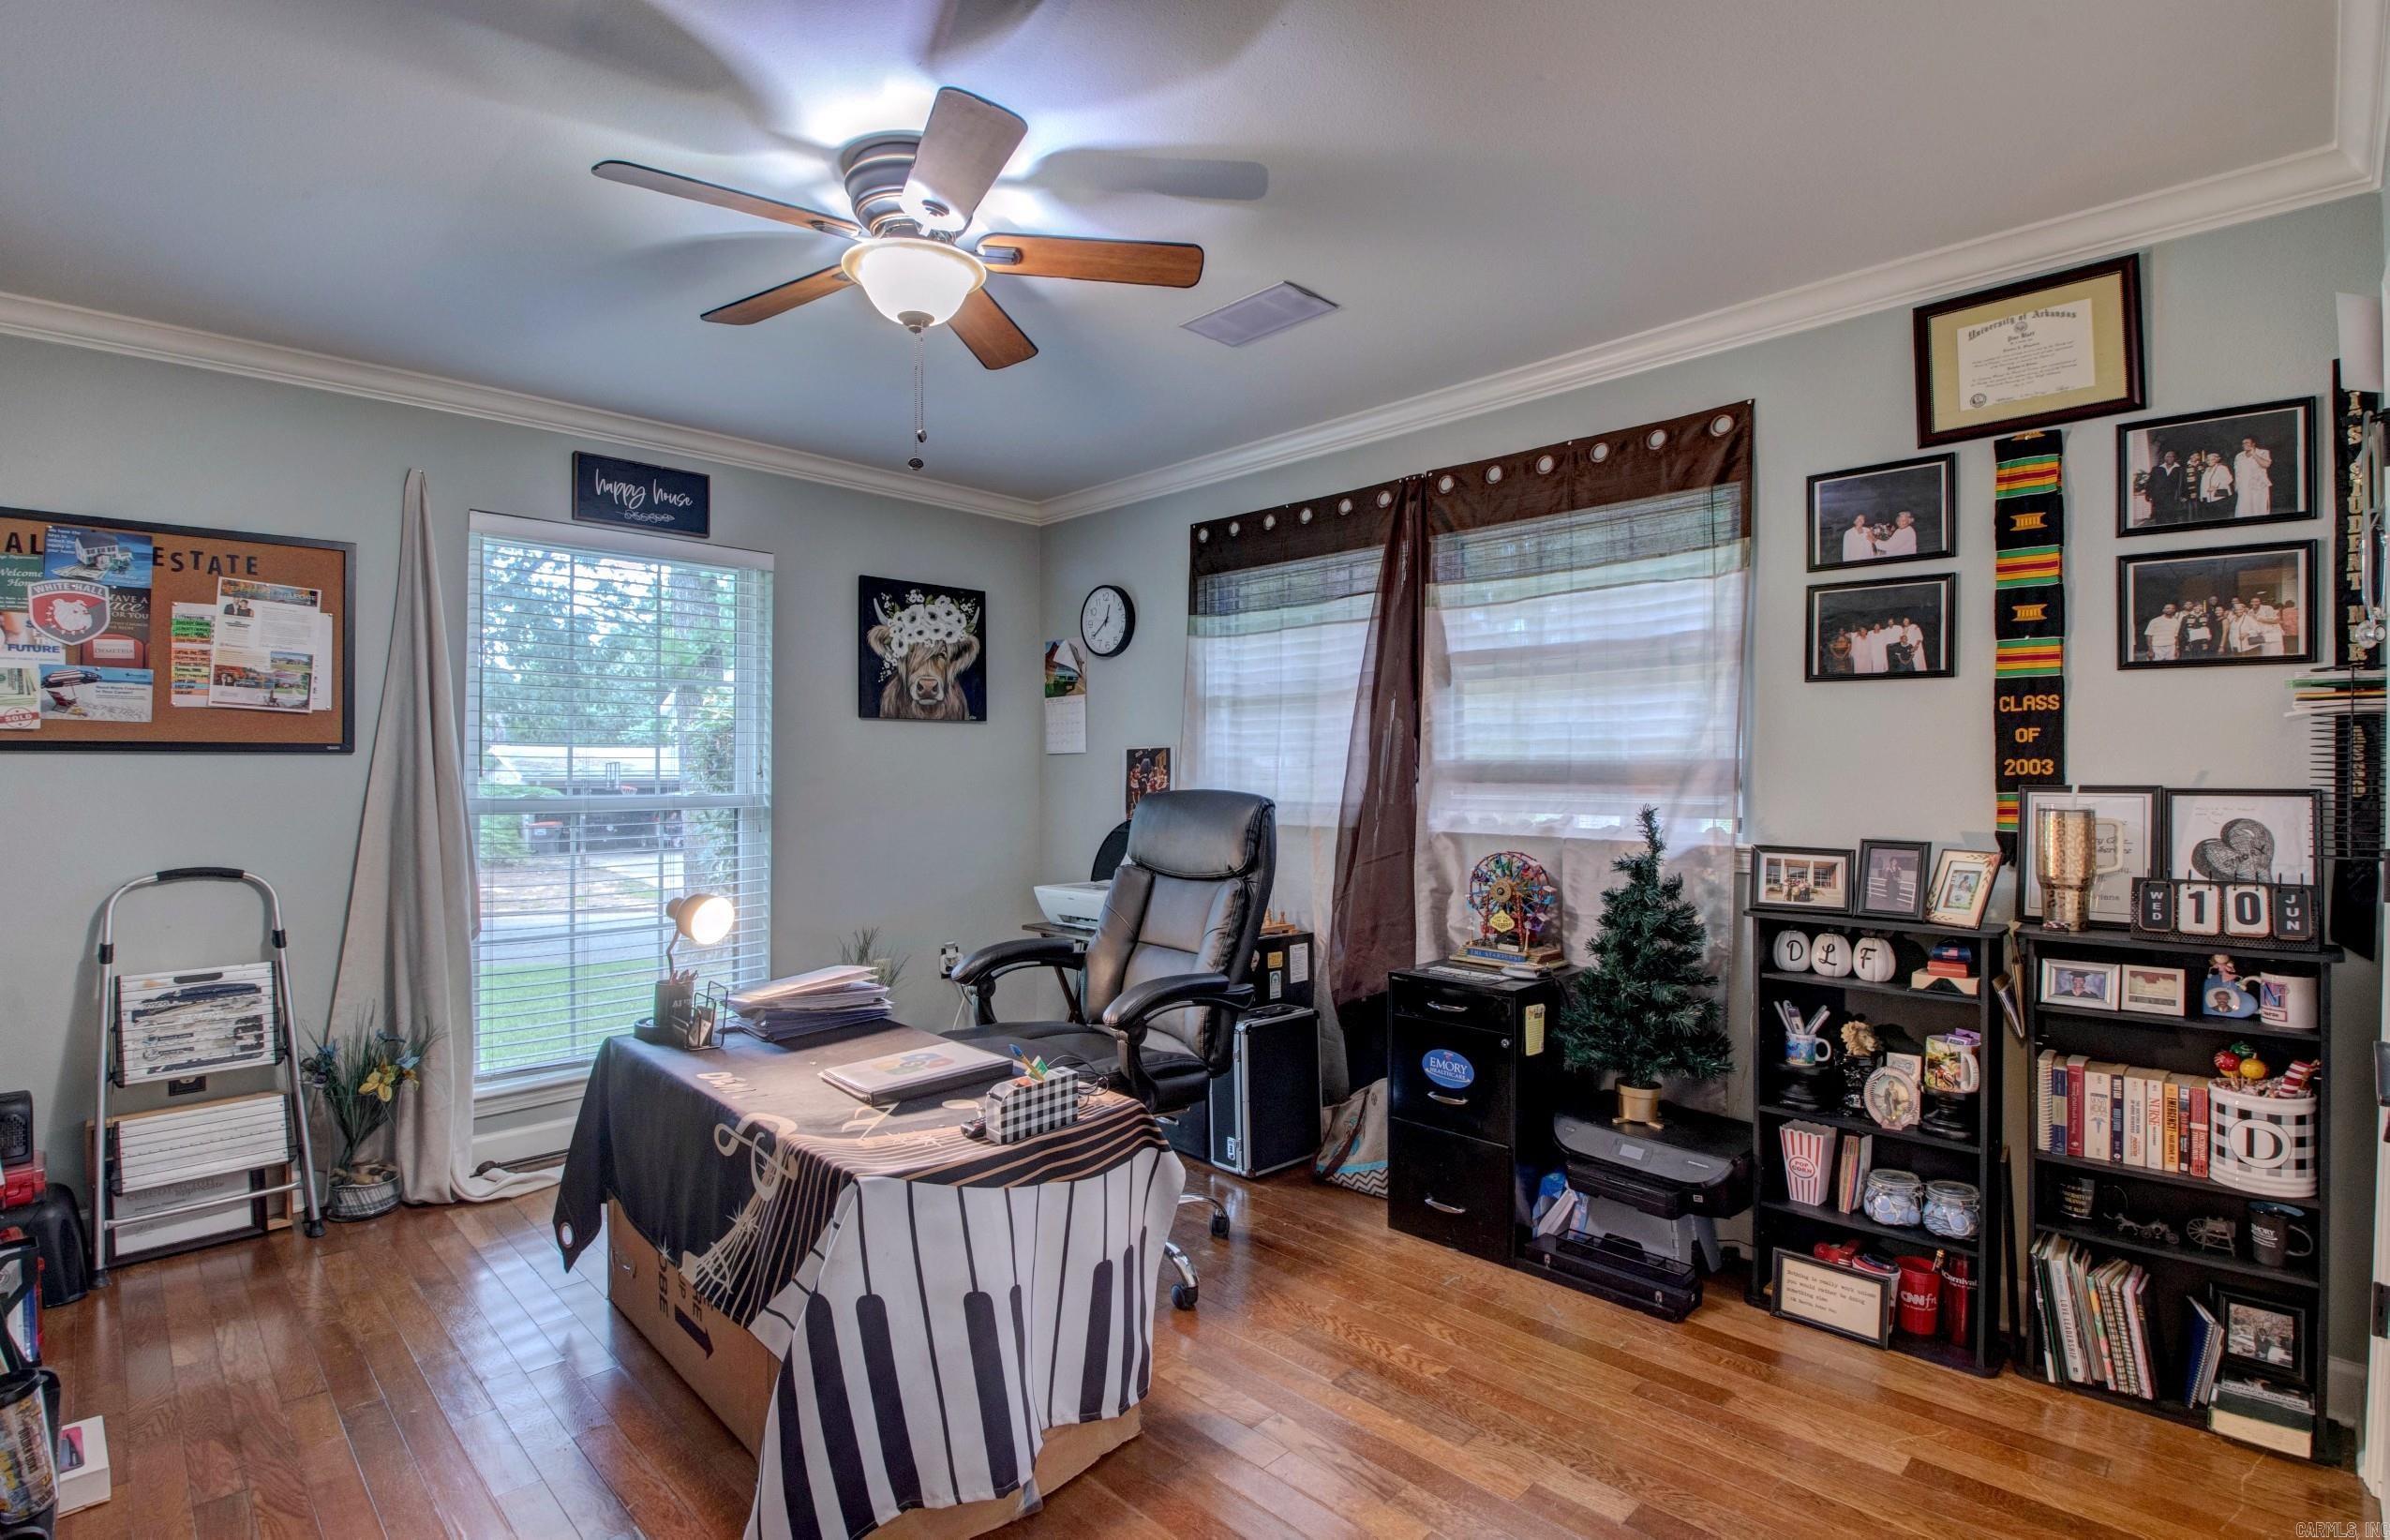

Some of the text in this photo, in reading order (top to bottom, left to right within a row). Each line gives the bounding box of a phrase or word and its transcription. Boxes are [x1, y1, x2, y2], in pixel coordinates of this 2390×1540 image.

[1968, 317, 2015, 341] University
[2032, 309, 2077, 319] Arkansas
[595, 468, 694, 510] happy house
[153, 546, 259, 576] ESTATE
[34, 583, 106, 596] WHITE HALL
[7, 643, 61, 653] FUTURE
[1998, 695, 2060, 712] CLASS
[5, 713, 33, 723] SOLD
[2015, 727, 2041, 743] OF
[2004, 758, 2054, 776] 2003
[2150, 891, 2164, 920] WED
[2284, 893, 2300, 931] JUN
[1786, 939, 1804, 962] D
[1817, 944, 1838, 966] L
[1860, 948, 1877, 970] F
[1429, 1056, 1468, 1075] EMORY
[1429, 1067, 1467, 1081] HEALTHCARE
[2148, 1097, 2160, 1127] NURSE
[2166, 1097, 2177, 1132] EMERGENCY!
[2243, 1127, 2284, 1160] D
[1790, 1164, 1814, 1174] CORN
[1794, 1159, 1809, 1168] POP
[1943, 1269, 1979, 1287] Carnival
[2060, 1299, 2070, 1317] LOVE
[2062, 1318, 2077, 1359] LEADERSHIP
